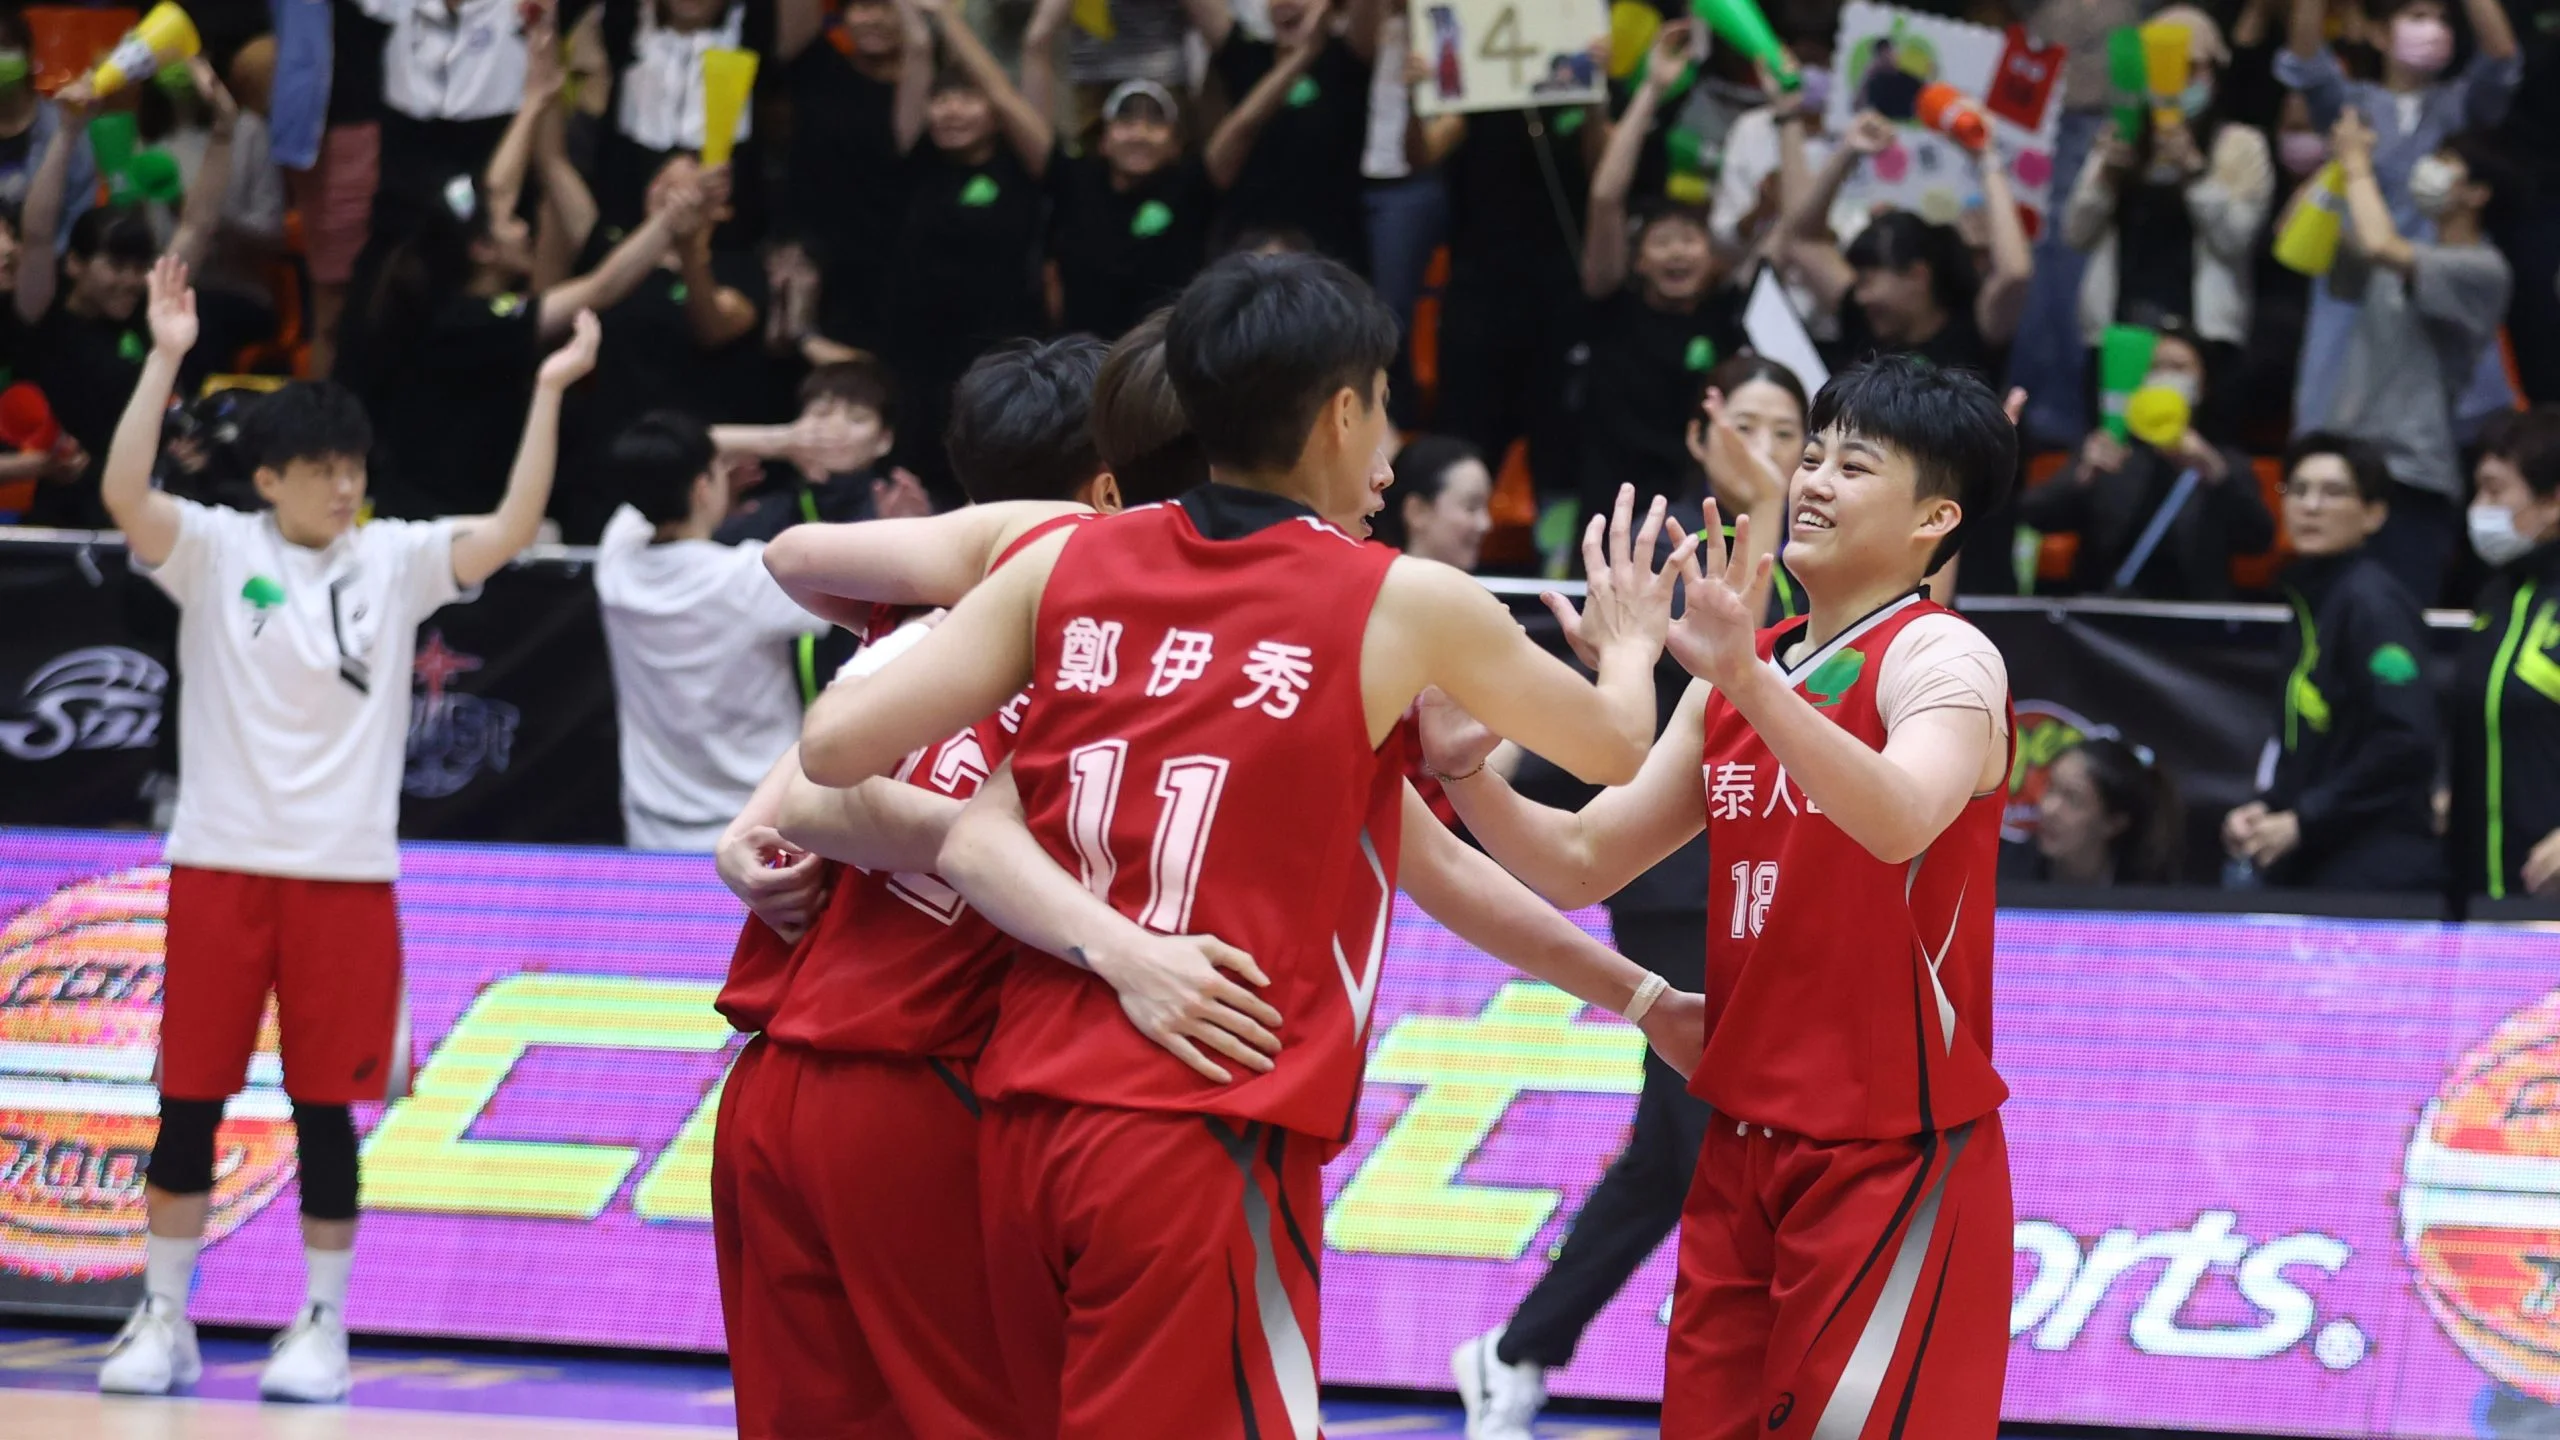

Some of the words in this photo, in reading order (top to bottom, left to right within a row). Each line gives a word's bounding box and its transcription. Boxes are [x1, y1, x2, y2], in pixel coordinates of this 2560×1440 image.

[1478, 6, 1541, 90] 4
[1055, 616, 1313, 719] 鄭伊秀
[1067, 738, 1230, 935] 11
[1702, 761, 1824, 820] 泰人
[1721, 860, 1779, 939] 18
[2009, 1209, 2367, 1370] orts.
